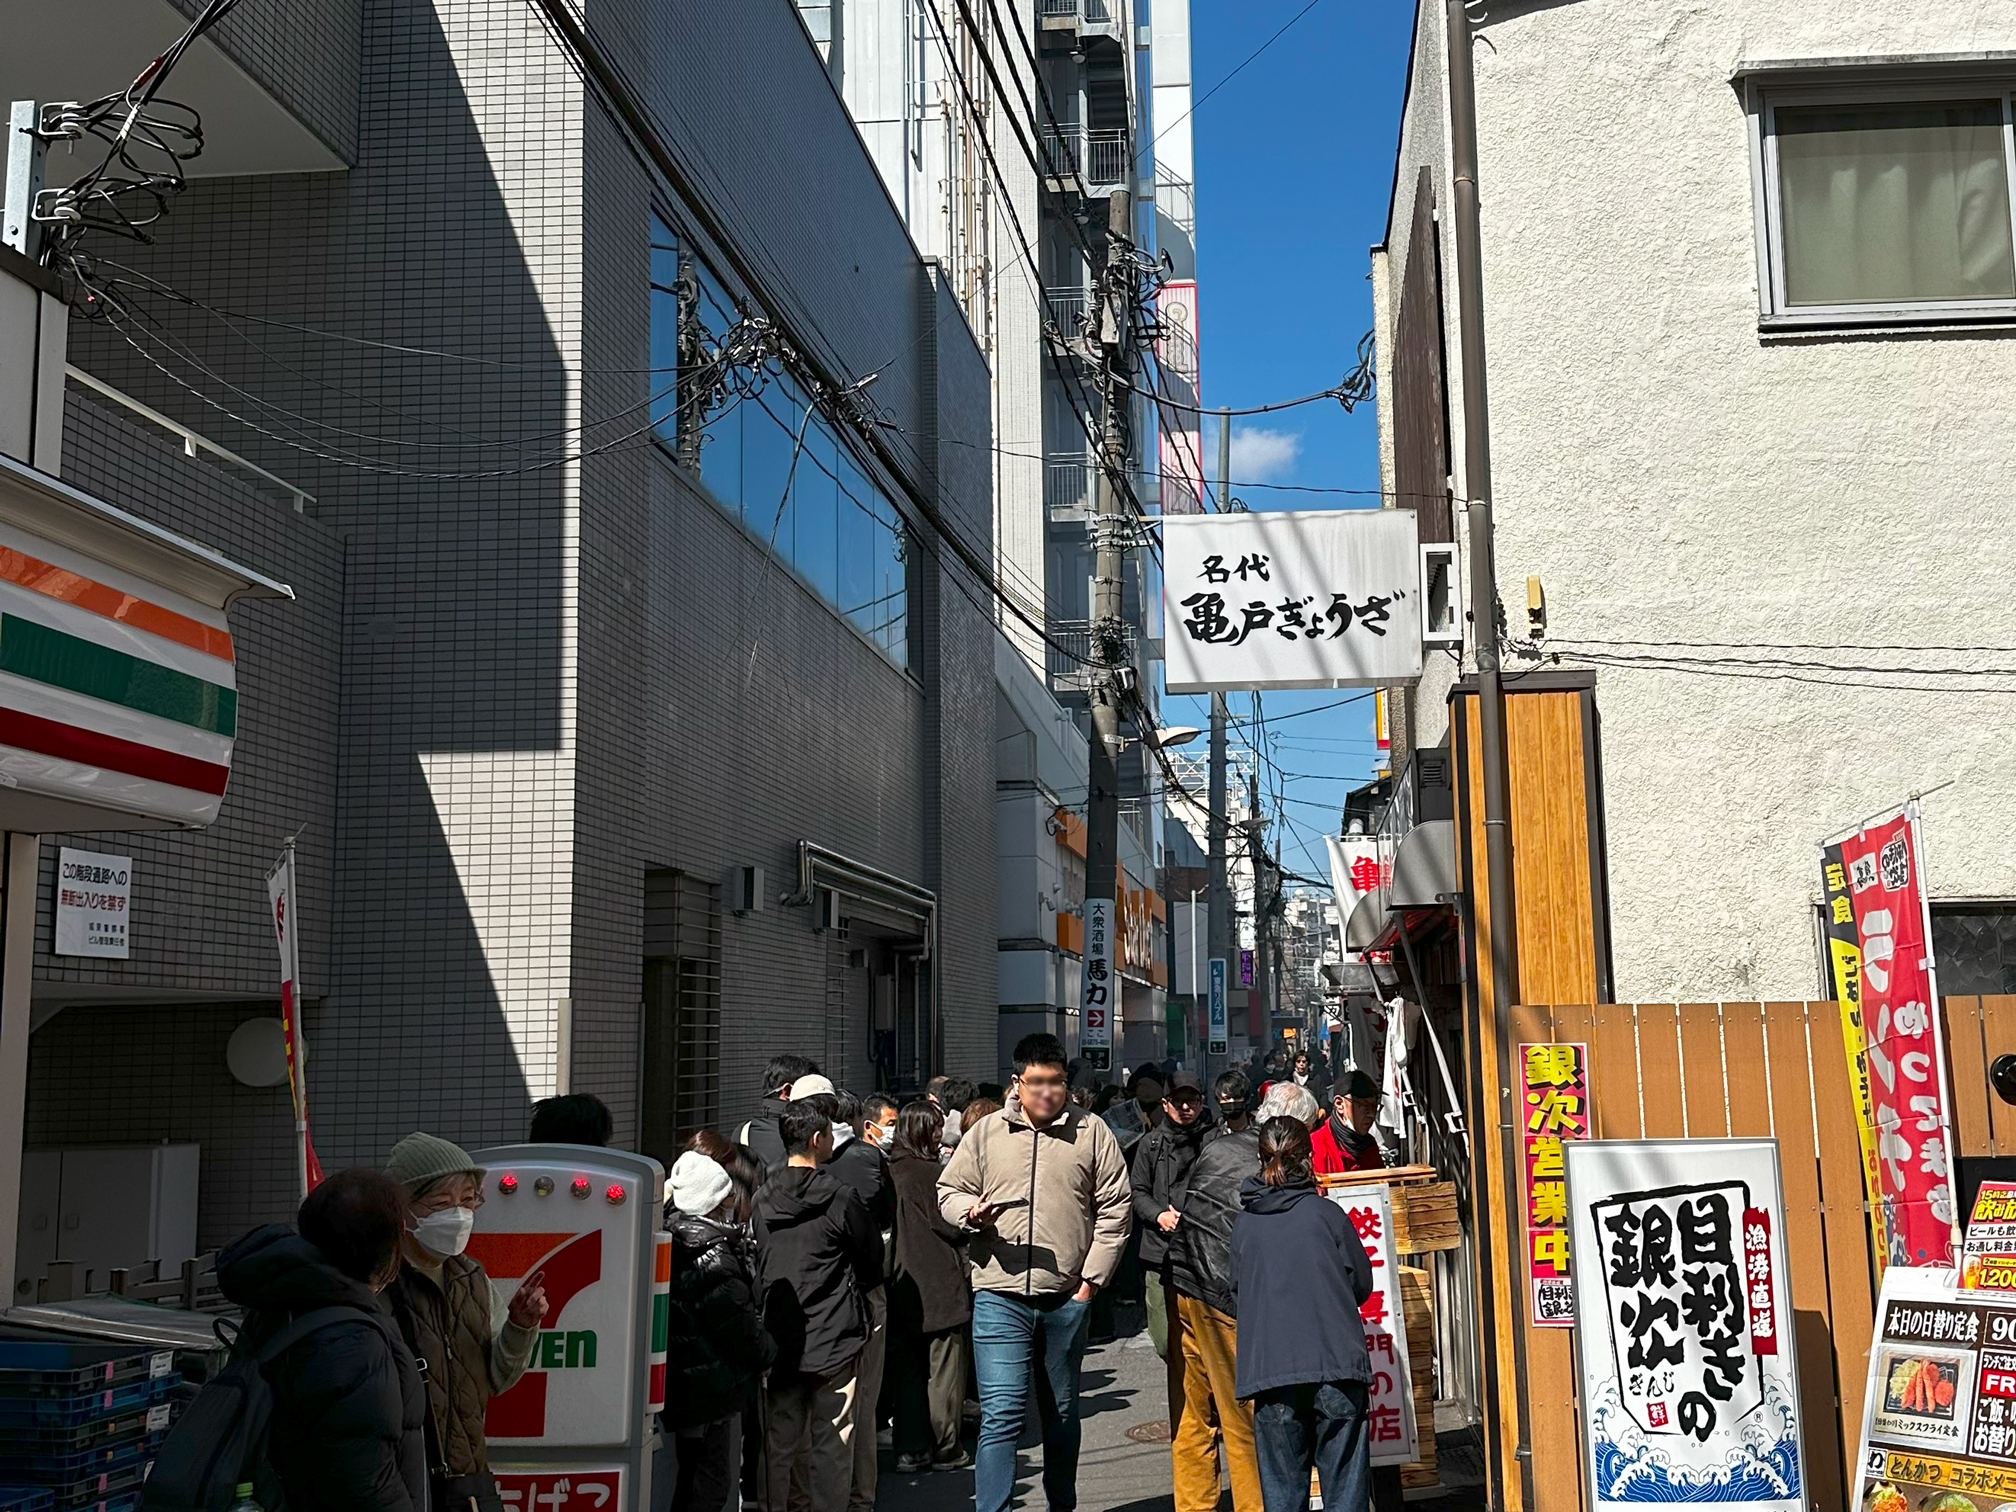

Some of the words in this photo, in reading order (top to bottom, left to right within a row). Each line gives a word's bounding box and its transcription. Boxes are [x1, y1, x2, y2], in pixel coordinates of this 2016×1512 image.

[1196, 553, 1270, 583] 名代
[1180, 588, 1406, 646] 亀戸ぎょうざ
[62, 863, 128, 886] この階段通路への
[1825, 862, 1853, 924] 定食
[61, 888, 126, 911] 無断出入りを禁ず
[1091, 903, 1105, 956] 大衆酒場
[1086, 959, 1108, 1005] 馬力
[1861, 908, 1912, 1192] ランチ
[1525, 1046, 1580, 1272] 銀次営業中
[1966, 1241, 2016, 1252] お通し料金
[1543, 1286, 1573, 1300] 目利
[1605, 1203, 1684, 1371] 銀次
[1745, 1224, 1774, 1338] 漁港直送
[1677, 1193, 1746, 1442] 目利きの
[1887, 1306, 1980, 1342] 本日の日替り定食
[1629, 1372, 1675, 1397] ぎんじ
[1890, 1457, 1942, 1479] とんかつ
